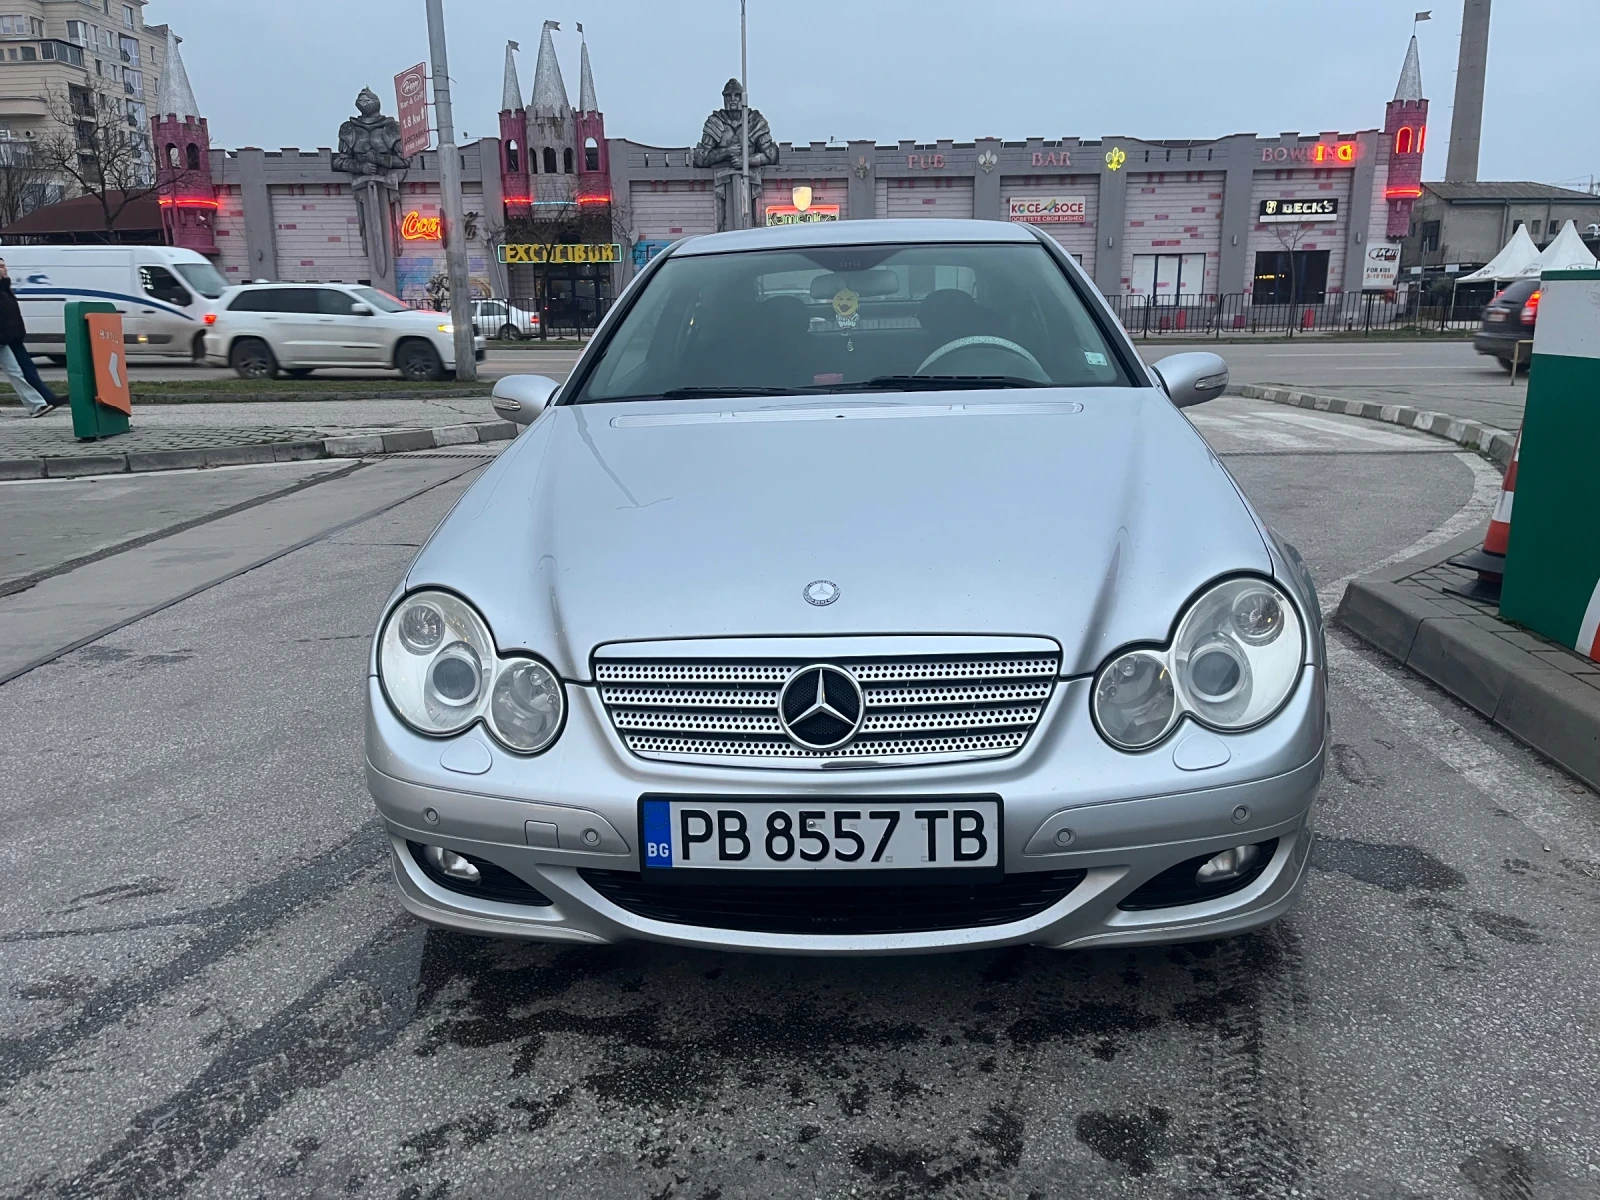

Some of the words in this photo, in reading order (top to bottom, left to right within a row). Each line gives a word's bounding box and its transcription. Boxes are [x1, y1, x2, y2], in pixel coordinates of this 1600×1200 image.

[1031, 151, 1072, 167] BAR
[1261, 144, 1353, 162] BOWLING
[908, 154, 945, 169] PUB
[1054, 203, 1084, 213] БОСЕ
[1282, 200, 1334, 214] BECK'S
[680, 809, 750, 861] PB
[765, 810, 901, 863] 8557
[914, 809, 988, 862] TB
[647, 842, 669, 859] BG
